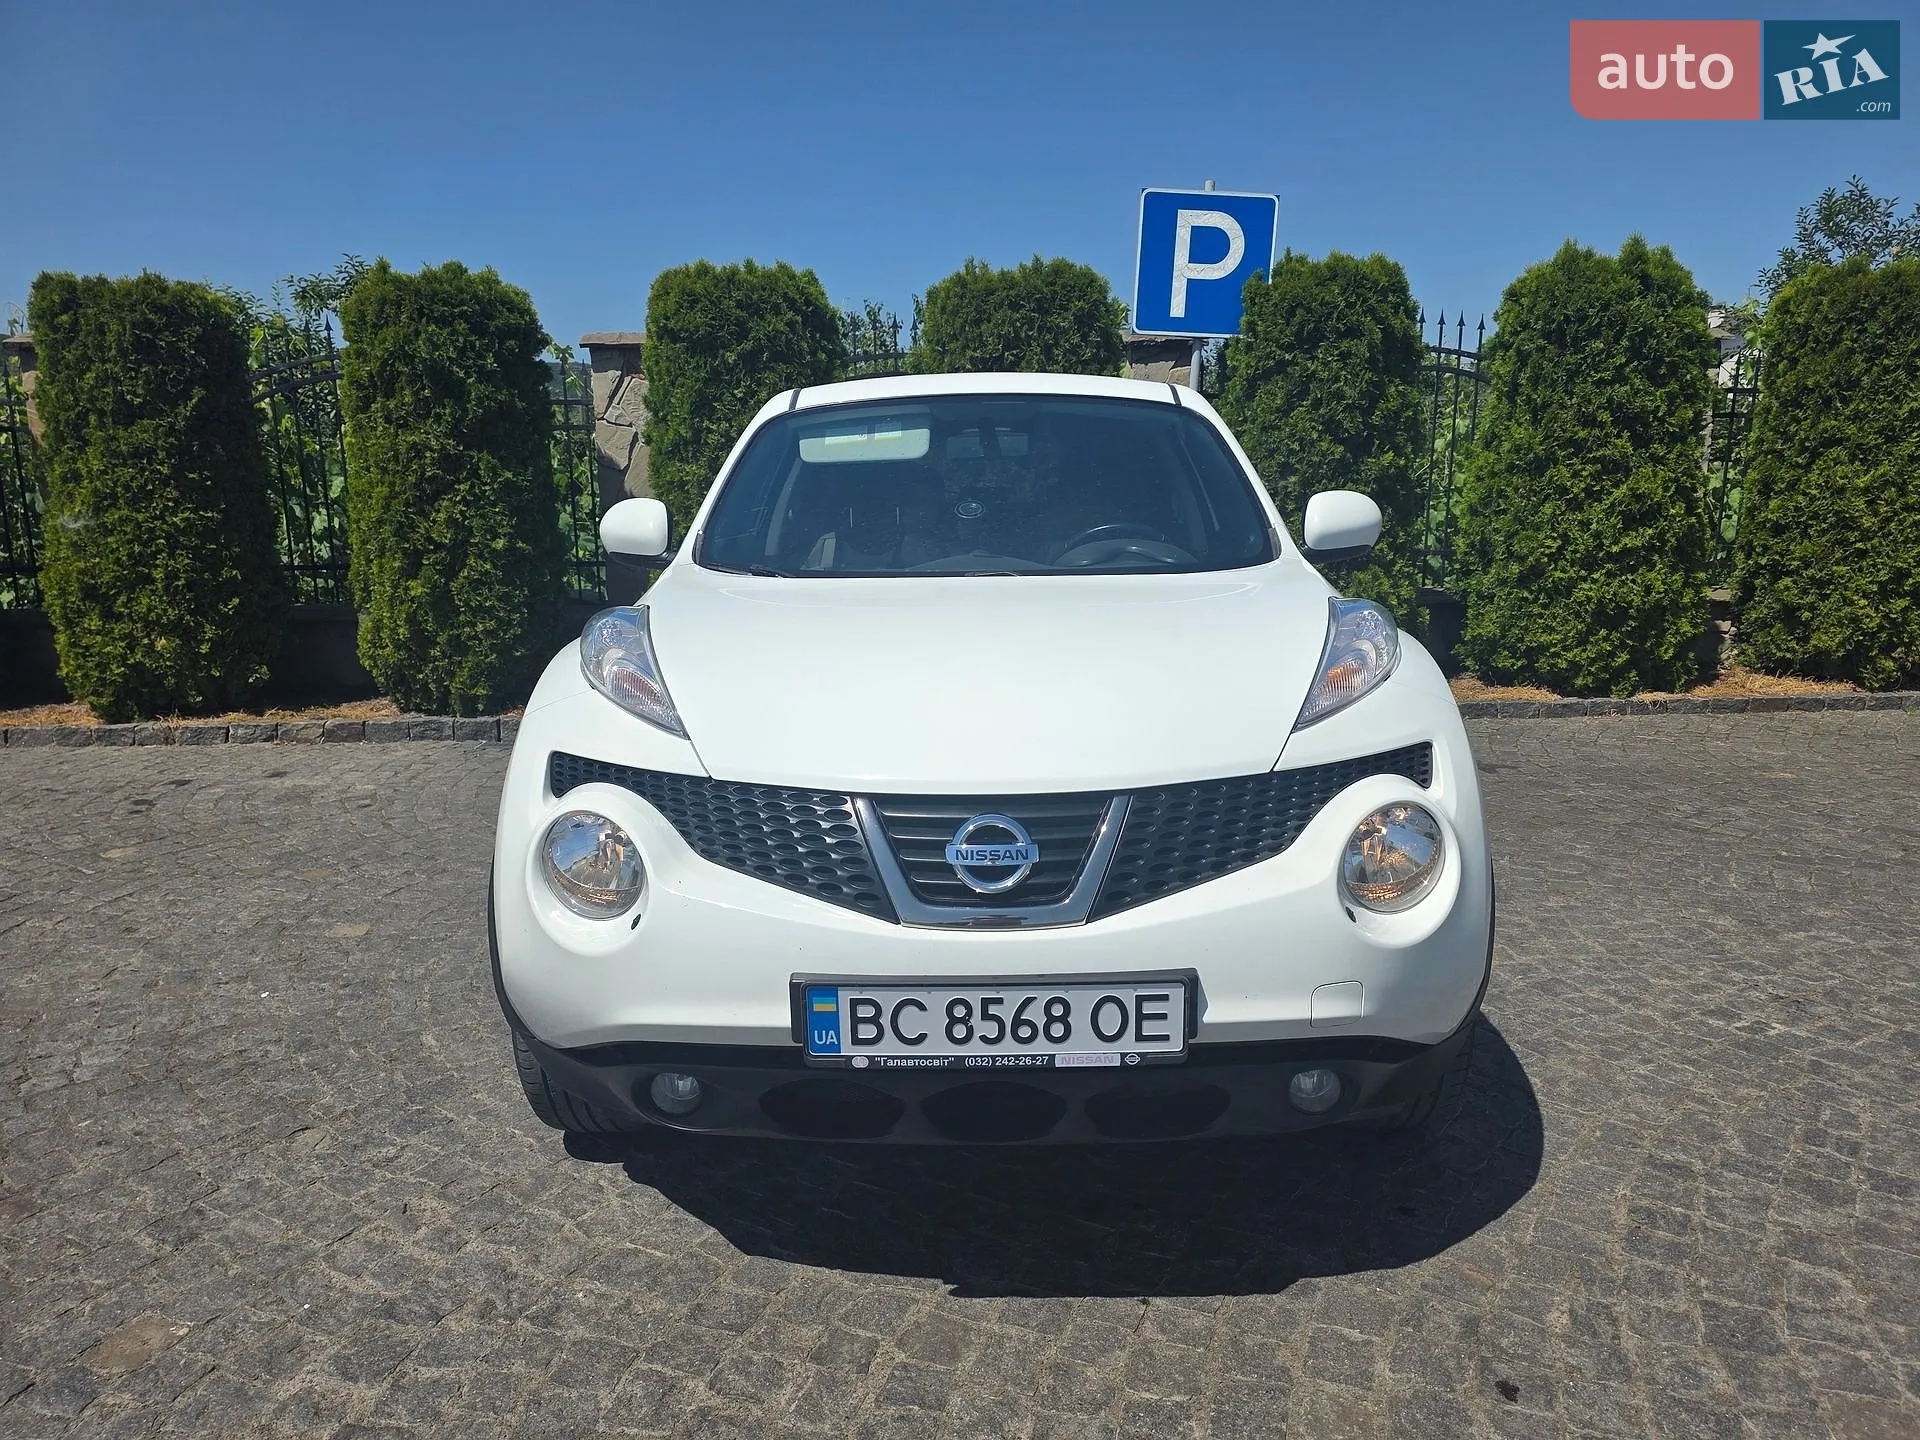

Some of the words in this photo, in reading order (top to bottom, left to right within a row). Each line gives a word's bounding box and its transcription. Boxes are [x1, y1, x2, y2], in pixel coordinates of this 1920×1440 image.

[1169, 209, 1245, 318] P
[955, 848, 1029, 861] NISSAN
[849, 996, 928, 1046] BC
[944, 995, 1072, 1045] 8568
[1089, 993, 1171, 1043] OE
[814, 1030, 838, 1044] UA
[875, 1057, 954, 1067] "Галавтосвіт"
[965, 1056, 993, 1067] (032)
[995, 1056, 1049, 1066] 242-26-27
[1060, 1056, 1114, 1065] NISSAN
